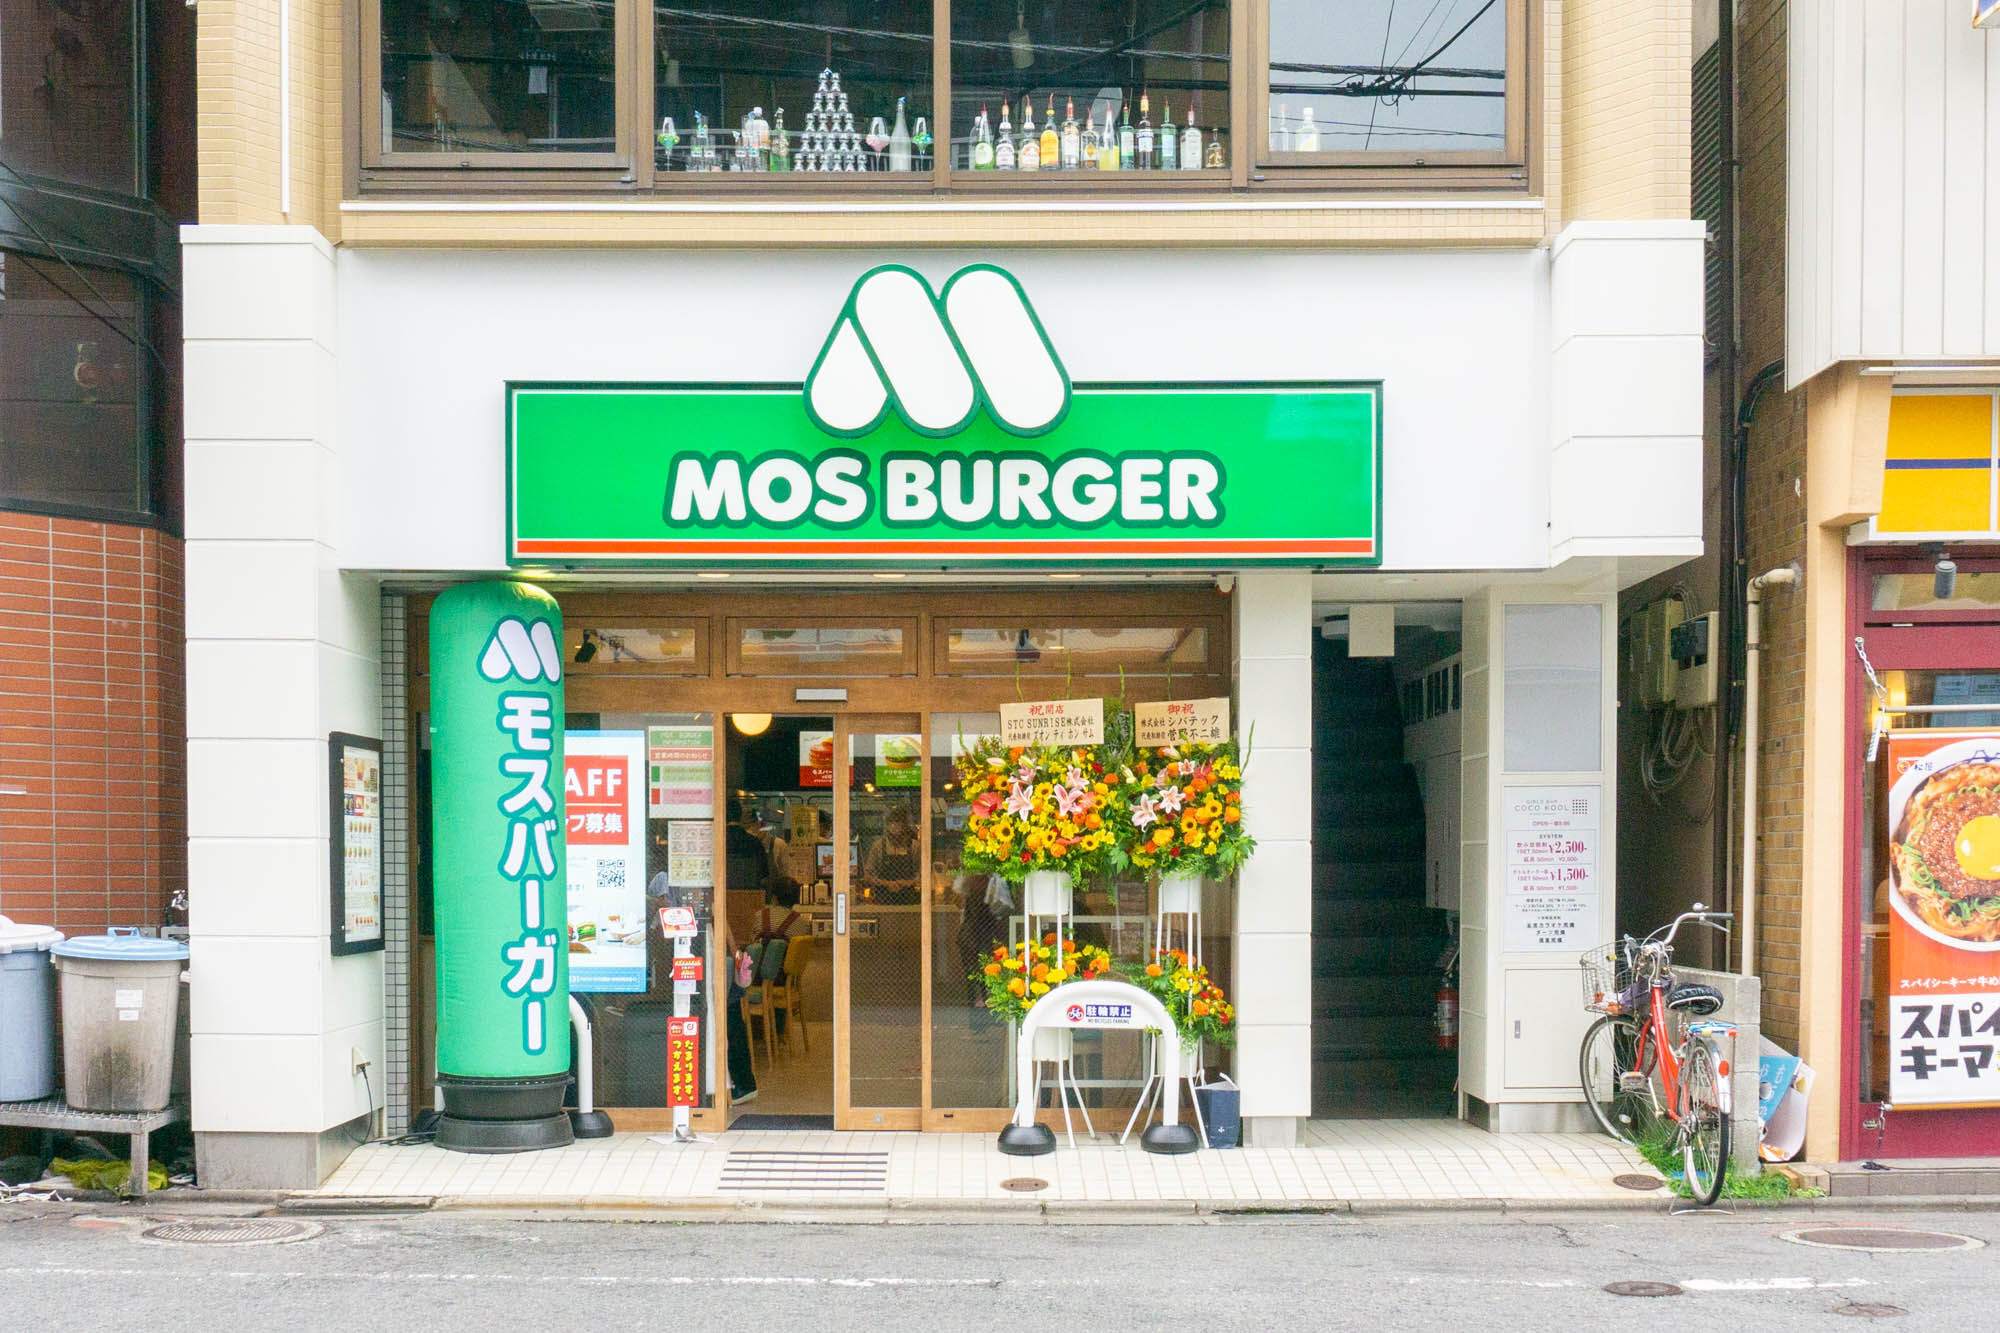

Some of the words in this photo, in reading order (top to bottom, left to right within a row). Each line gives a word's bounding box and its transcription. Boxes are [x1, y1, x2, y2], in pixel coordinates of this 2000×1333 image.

[670, 456, 870, 523] MOS
[887, 456, 1220, 523] BURGER
[1029, 703, 1064, 716] 祝開店
[1167, 703, 1195, 715] 御祝
[1007, 719, 1024, 730] STC
[1514, 804, 1541, 812] COCO
[500, 694, 558, 1053] モスバーガー
[1900, 975, 2000, 989] スパイシーキーマ牛め
[1086, 1005, 1131, 1017] 駐輪禁止
[1901, 1001, 2000, 1039] スパイ
[672, 1039, 682, 1102] つかえます。
[684, 1039, 694, 1102] たまります。
[1901, 1045, 1994, 1080] キーマ
